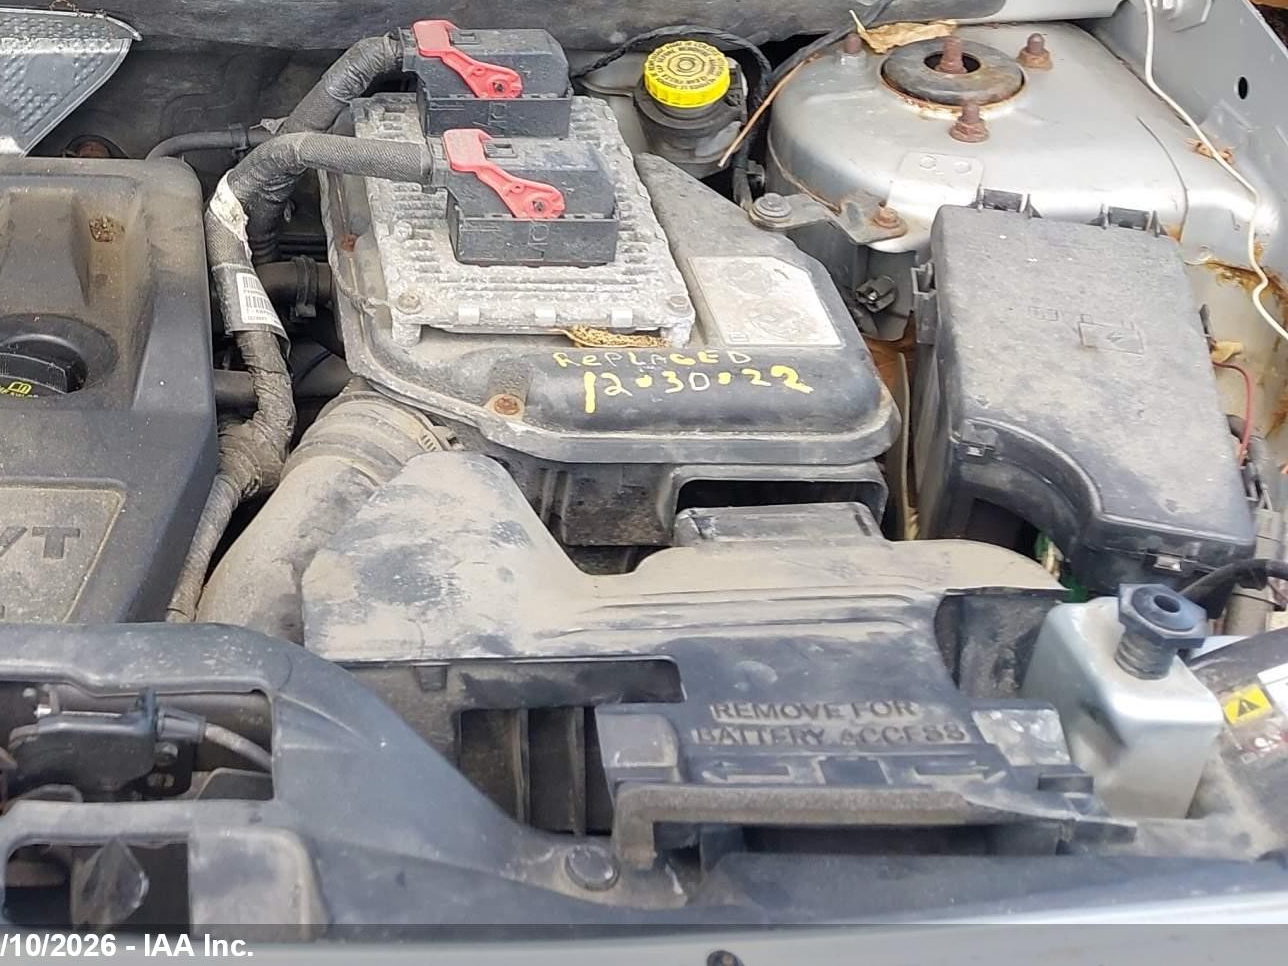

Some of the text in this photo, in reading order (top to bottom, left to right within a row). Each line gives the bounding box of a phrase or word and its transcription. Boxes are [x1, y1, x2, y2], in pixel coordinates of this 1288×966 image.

[712, 699, 919, 721] REMOVE FOR
[694, 723, 966, 747] BATTERY ACCESS
